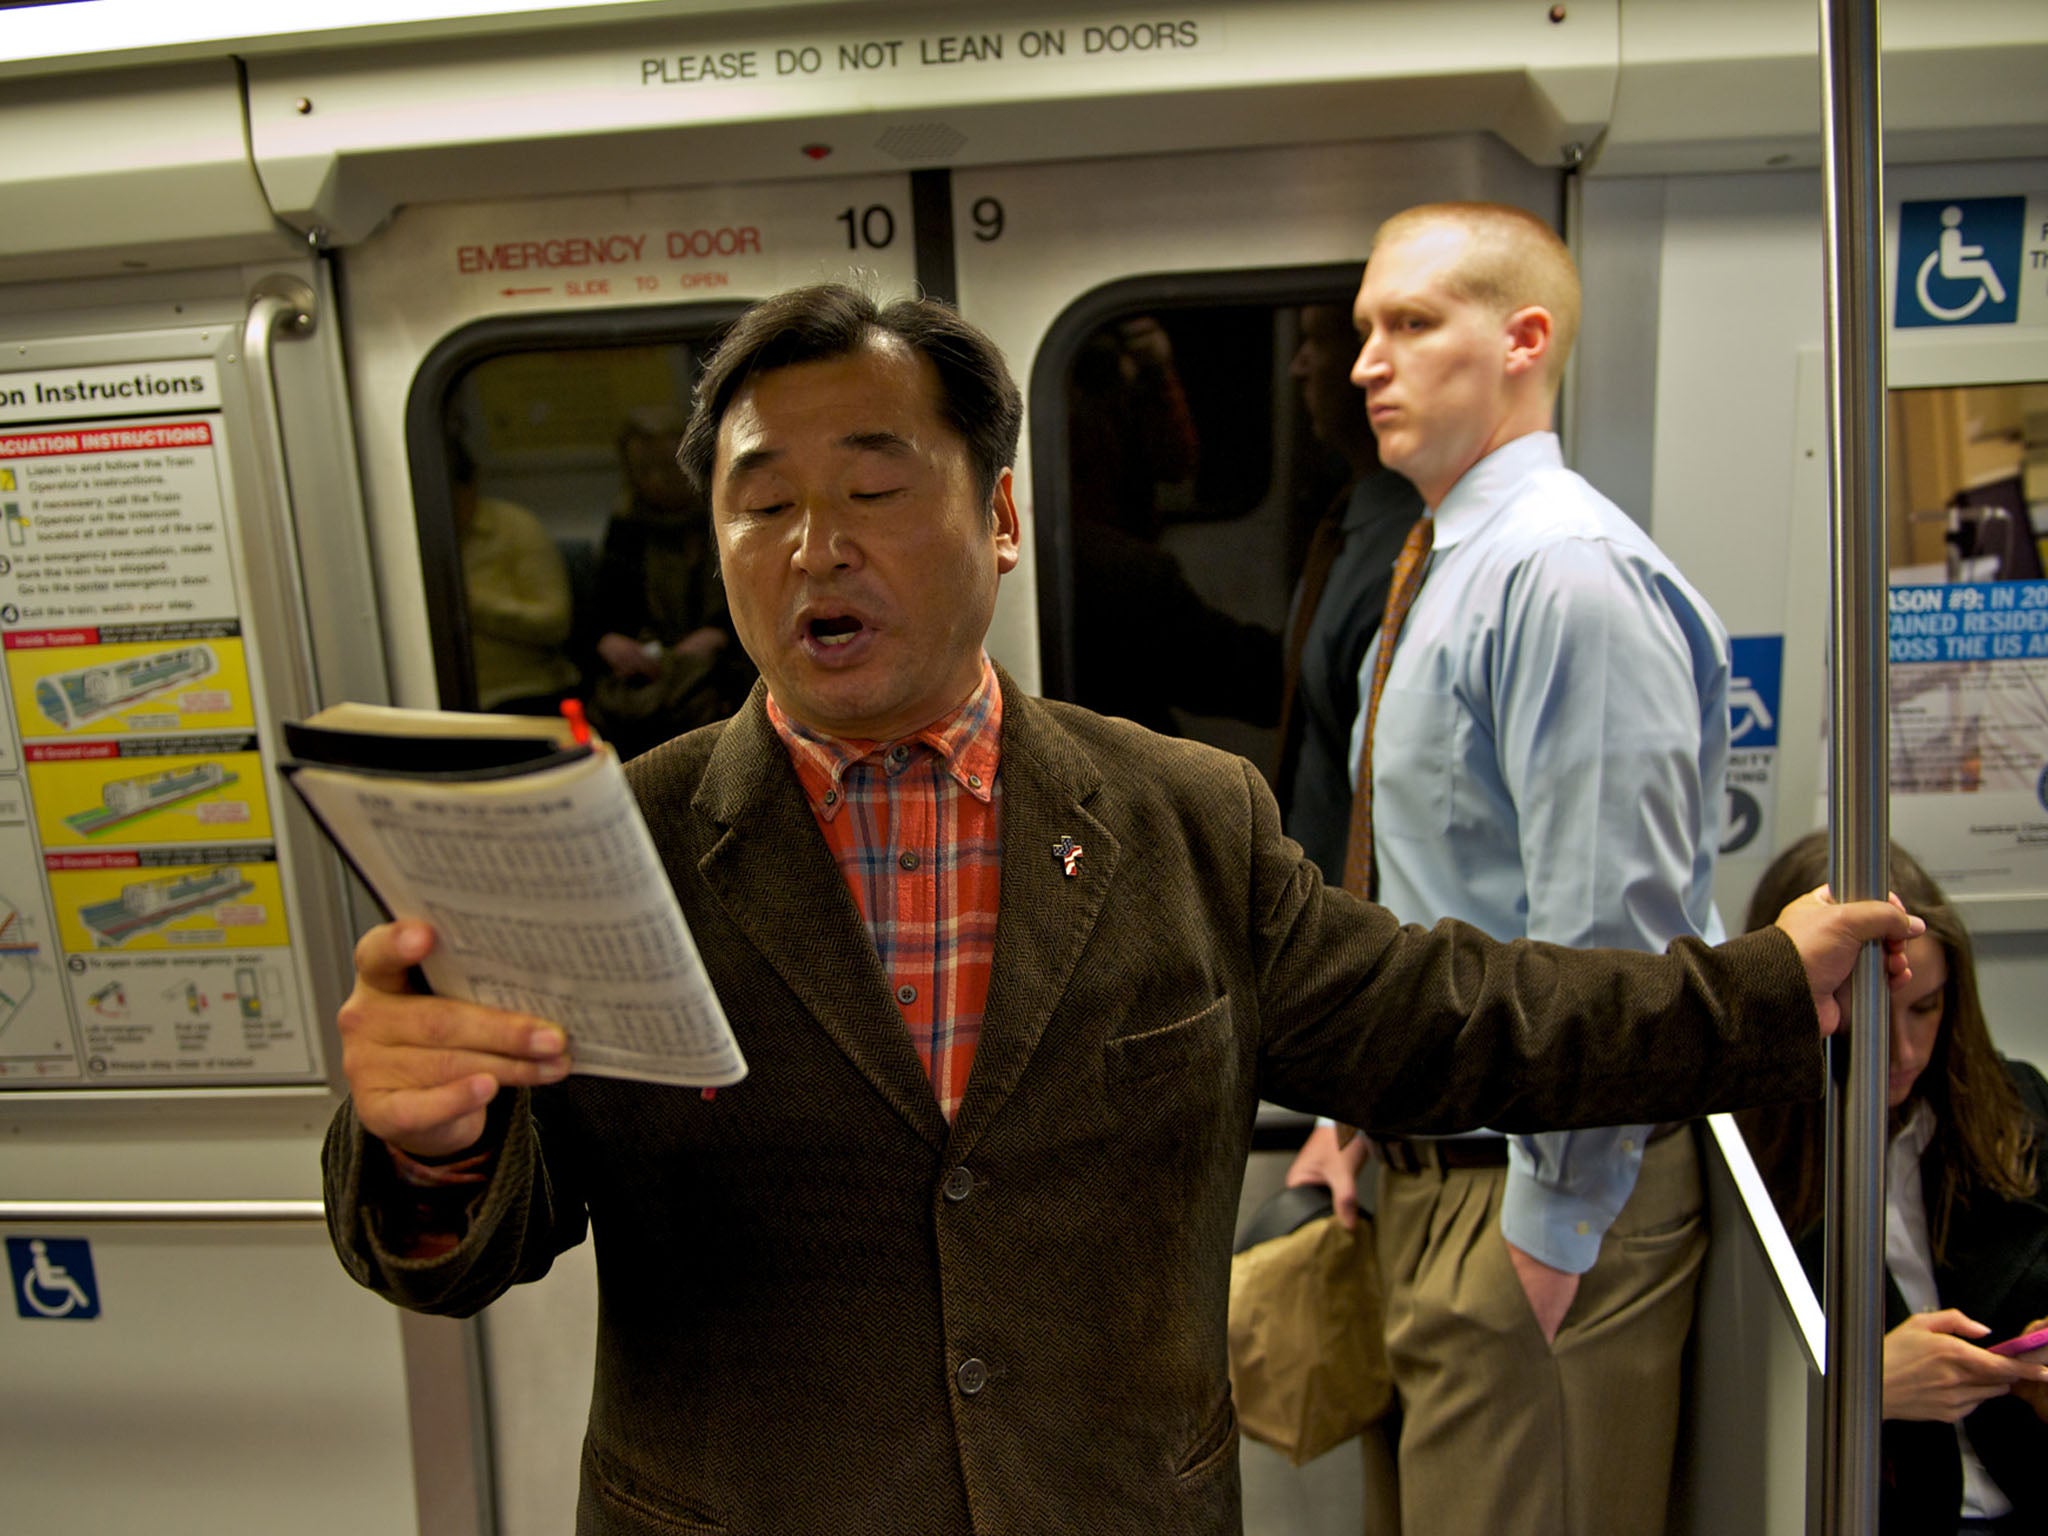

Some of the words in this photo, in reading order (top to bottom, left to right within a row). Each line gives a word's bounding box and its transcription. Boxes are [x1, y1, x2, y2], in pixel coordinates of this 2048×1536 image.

[640, 51, 757, 86] PLEASE
[775, 46, 822, 76] DO
[838, 39, 904, 71] NOT
[919, 33, 1003, 65] LEAN
[1018, 28, 1065, 58] ON
[1083, 19, 1199, 54] DOORS
[836, 203, 895, 250] 10
[971, 195, 1005, 243] 9
[457, 233, 647, 275] EMERGENCY
[665, 225, 762, 260] DOOR
[565, 278, 609, 297] SLIDE
[635, 274, 659, 292] TO
[680, 271, 729, 290] OPEN
[0, 388, 25, 407] on
[35, 374, 205, 404] Instructions
[81, 426, 210, 451] INSTRUCTIONS
[1948, 587, 1985, 612] #9:
[1991, 586, 2016, 610] IN
[1945, 633, 1987, 660] THE
[1992, 631, 2022, 657] US
